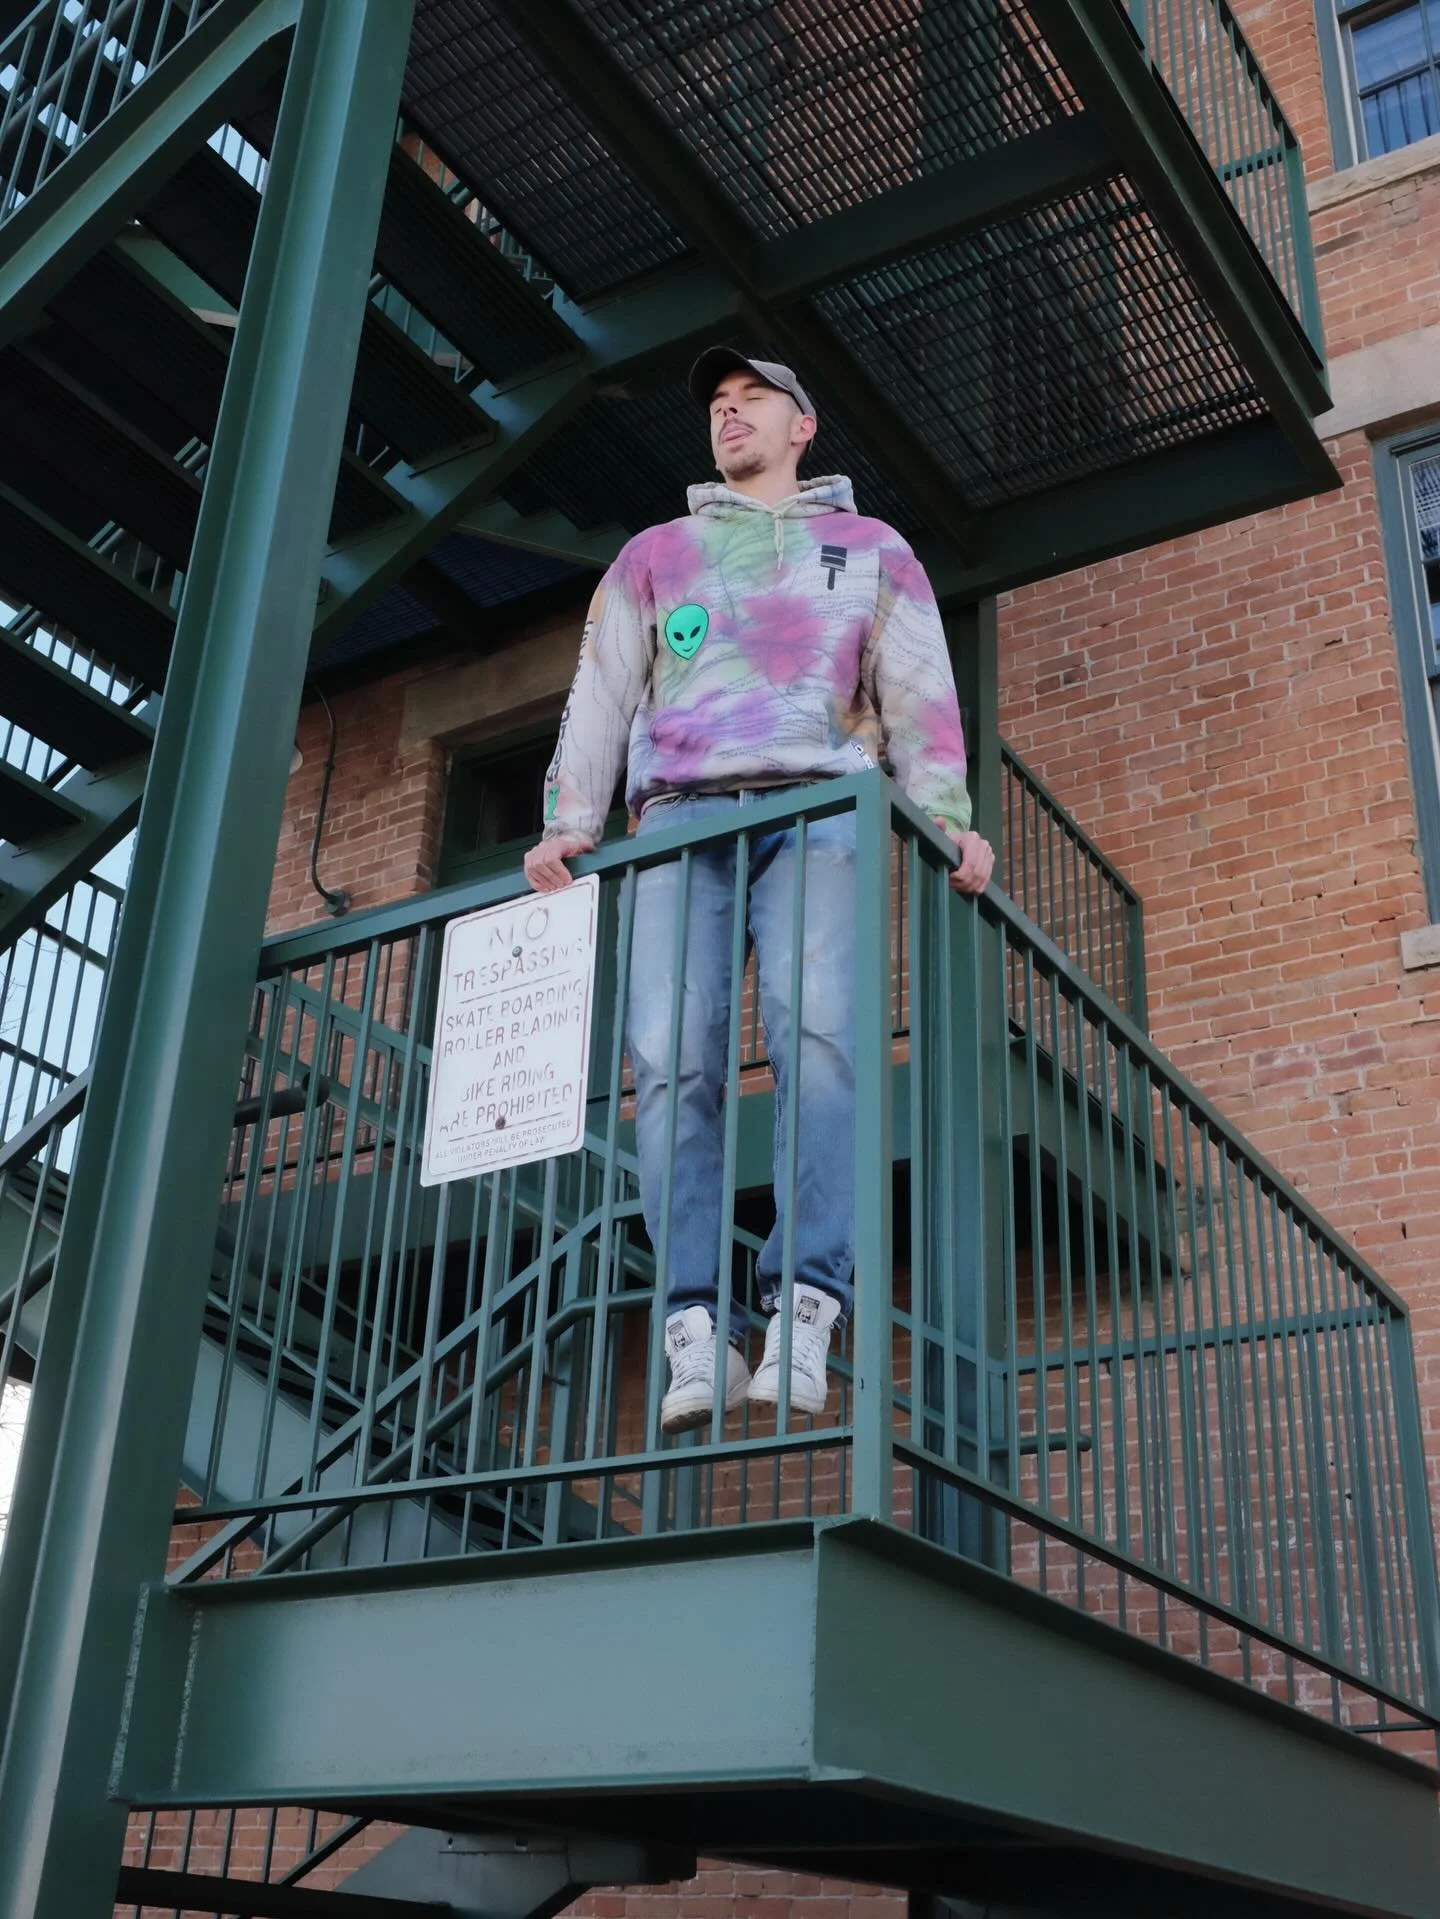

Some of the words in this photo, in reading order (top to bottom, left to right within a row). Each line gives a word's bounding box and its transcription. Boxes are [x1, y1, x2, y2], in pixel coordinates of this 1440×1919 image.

[489, 906, 549, 947] NO
[444, 1026, 505, 1058] ROLLER
[511, 1005, 580, 1040] BLADING
[492, 1045, 526, 1070] AND
[501, 1062, 554, 1094] RIDING
[476, 1083, 573, 1125] PROHIBITED
